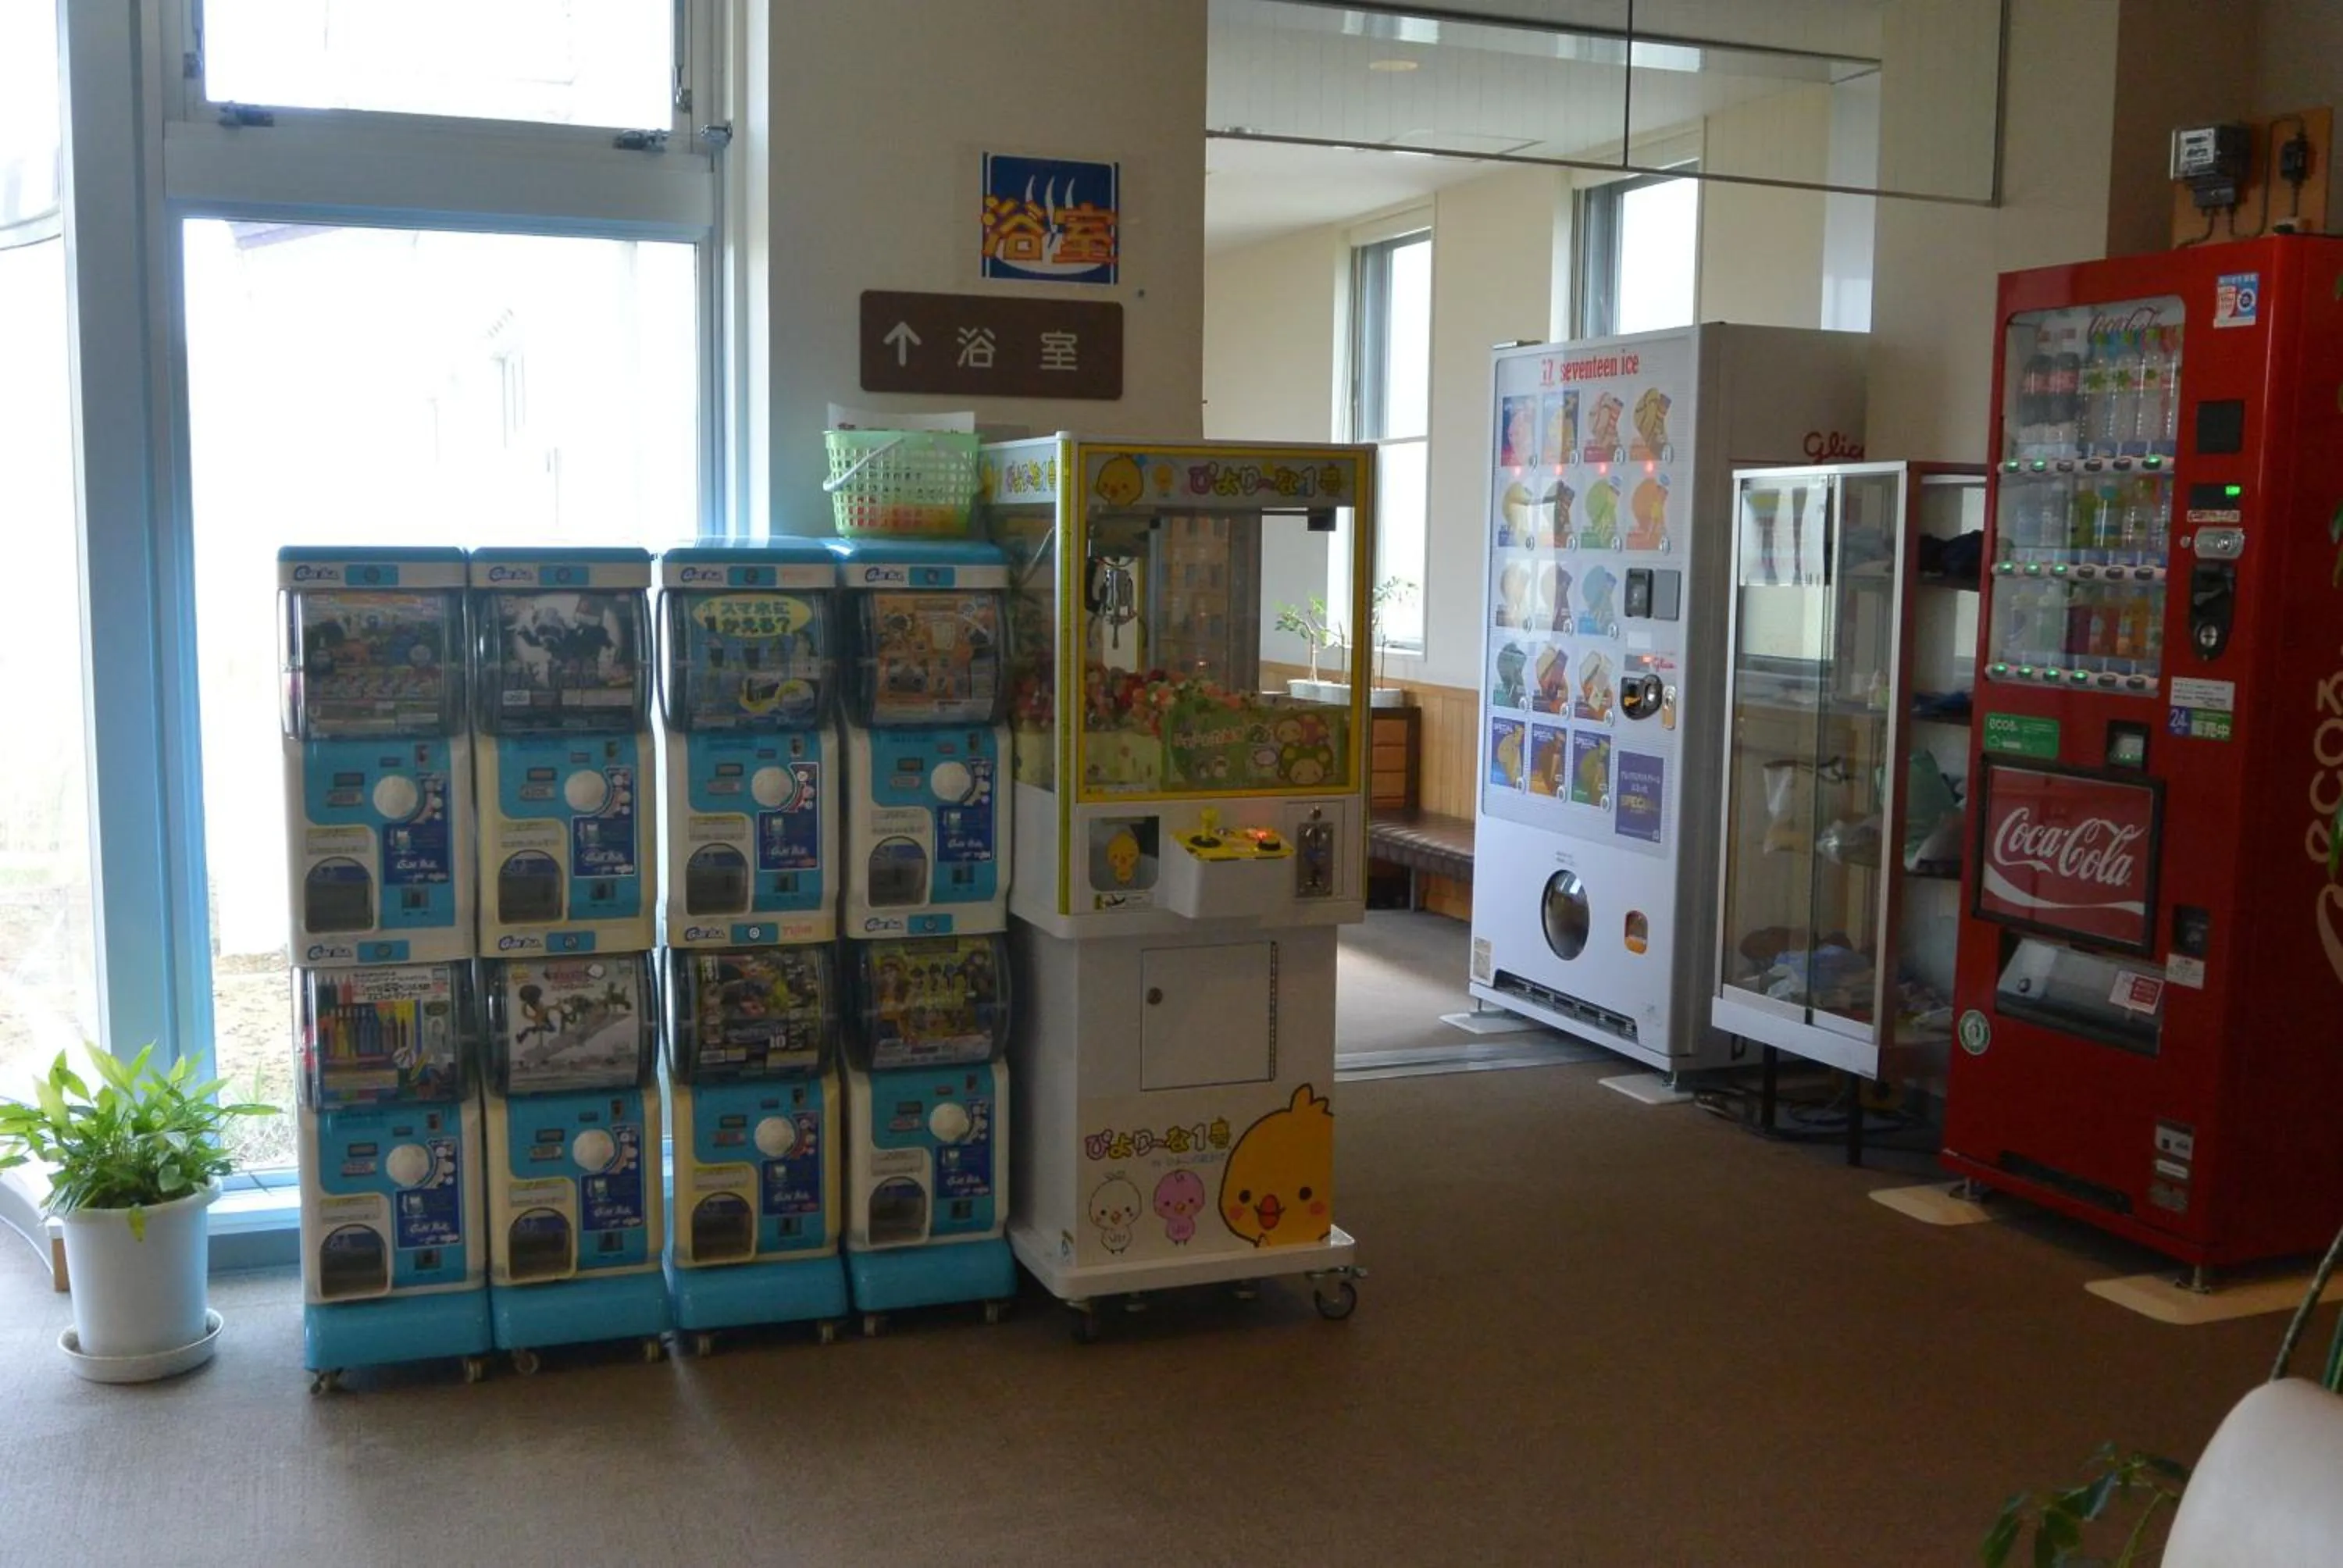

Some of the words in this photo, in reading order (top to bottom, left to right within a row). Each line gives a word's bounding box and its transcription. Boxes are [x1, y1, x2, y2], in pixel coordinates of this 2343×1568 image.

[981, 196, 1118, 265] 浴室
[956, 326, 1078, 371] 浴室
[1560, 355, 1618, 383] seventeen
[1620, 348, 1639, 376] ice
[1994, 807, 2147, 886] Coca-Cola
